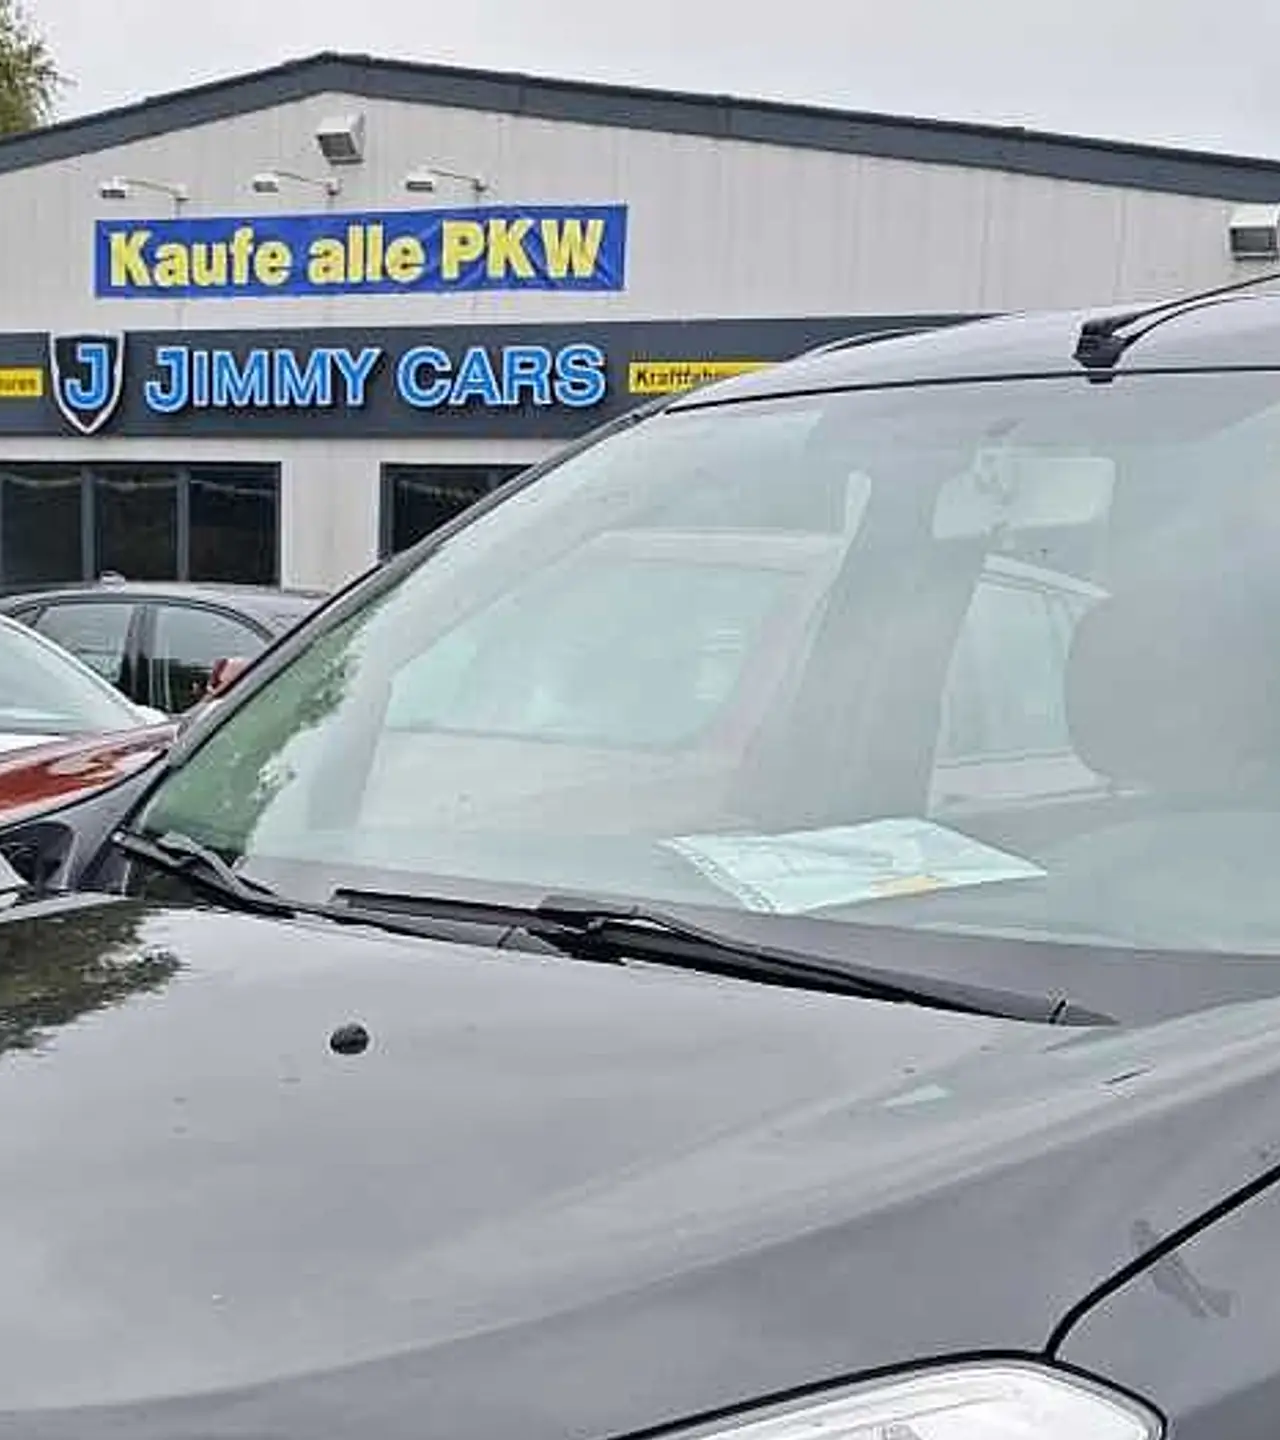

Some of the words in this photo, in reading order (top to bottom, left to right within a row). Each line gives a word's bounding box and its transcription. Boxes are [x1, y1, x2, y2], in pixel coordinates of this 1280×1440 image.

[109, 226, 294, 287] Kaufe
[307, 223, 426, 285] alle
[441, 218, 606, 280] PKW
[145, 345, 381, 413] JIMMY
[397, 343, 606, 409] CARS
